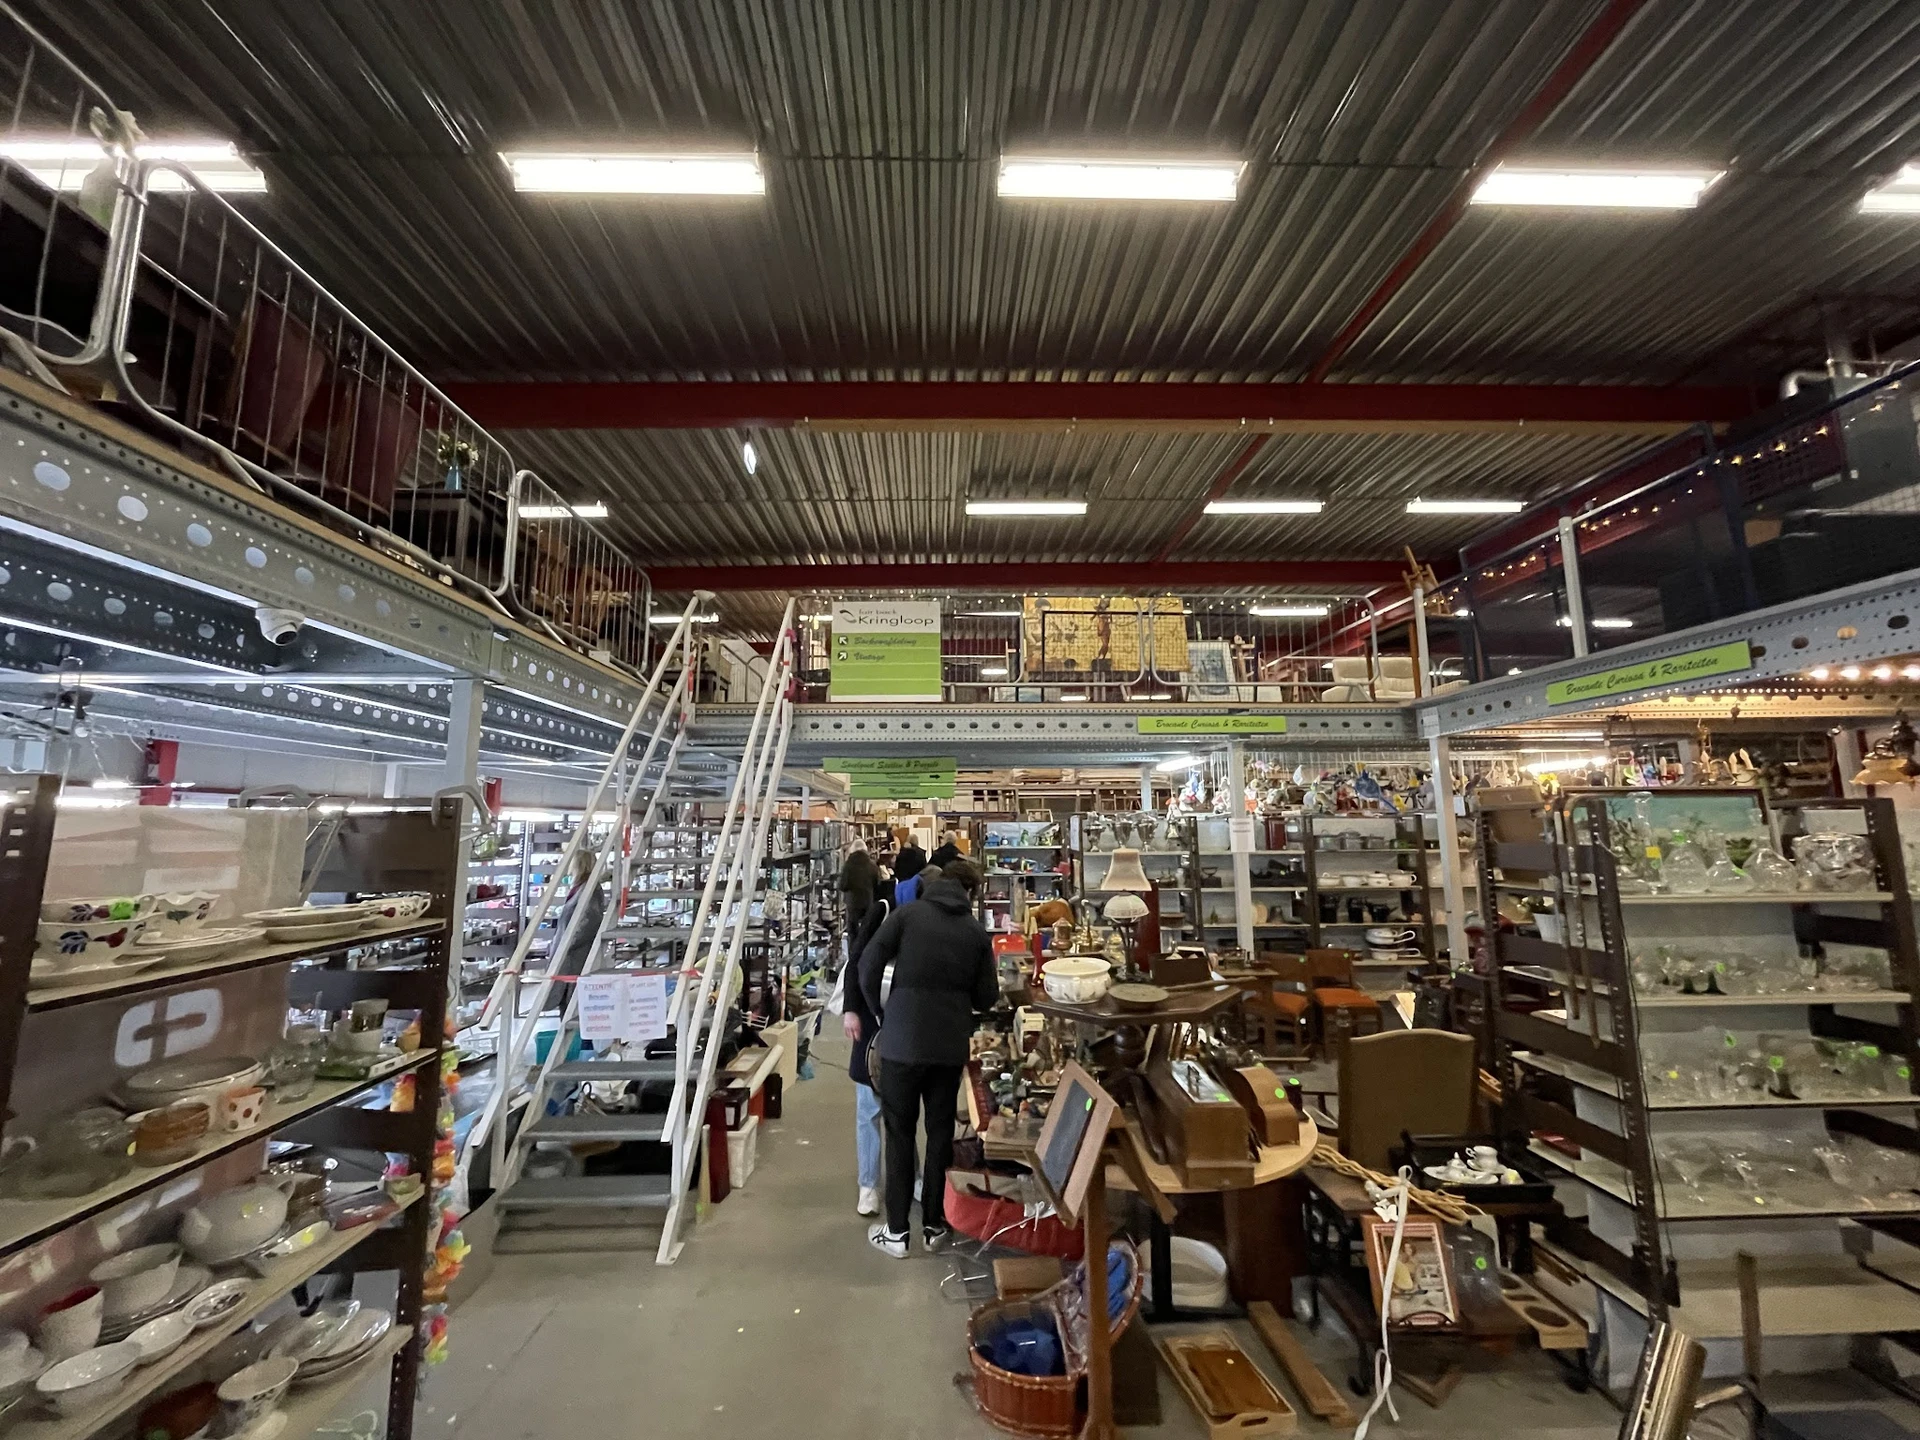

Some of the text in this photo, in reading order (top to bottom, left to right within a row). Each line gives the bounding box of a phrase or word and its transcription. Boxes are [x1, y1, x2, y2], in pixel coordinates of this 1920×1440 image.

[859, 615, 934, 627] Kringloop
[1566, 657, 1719, 696] Brocante Curiosa & Rariteiten
[1156, 719, 1269, 729] Brocante Curiosa & Rariteiten
